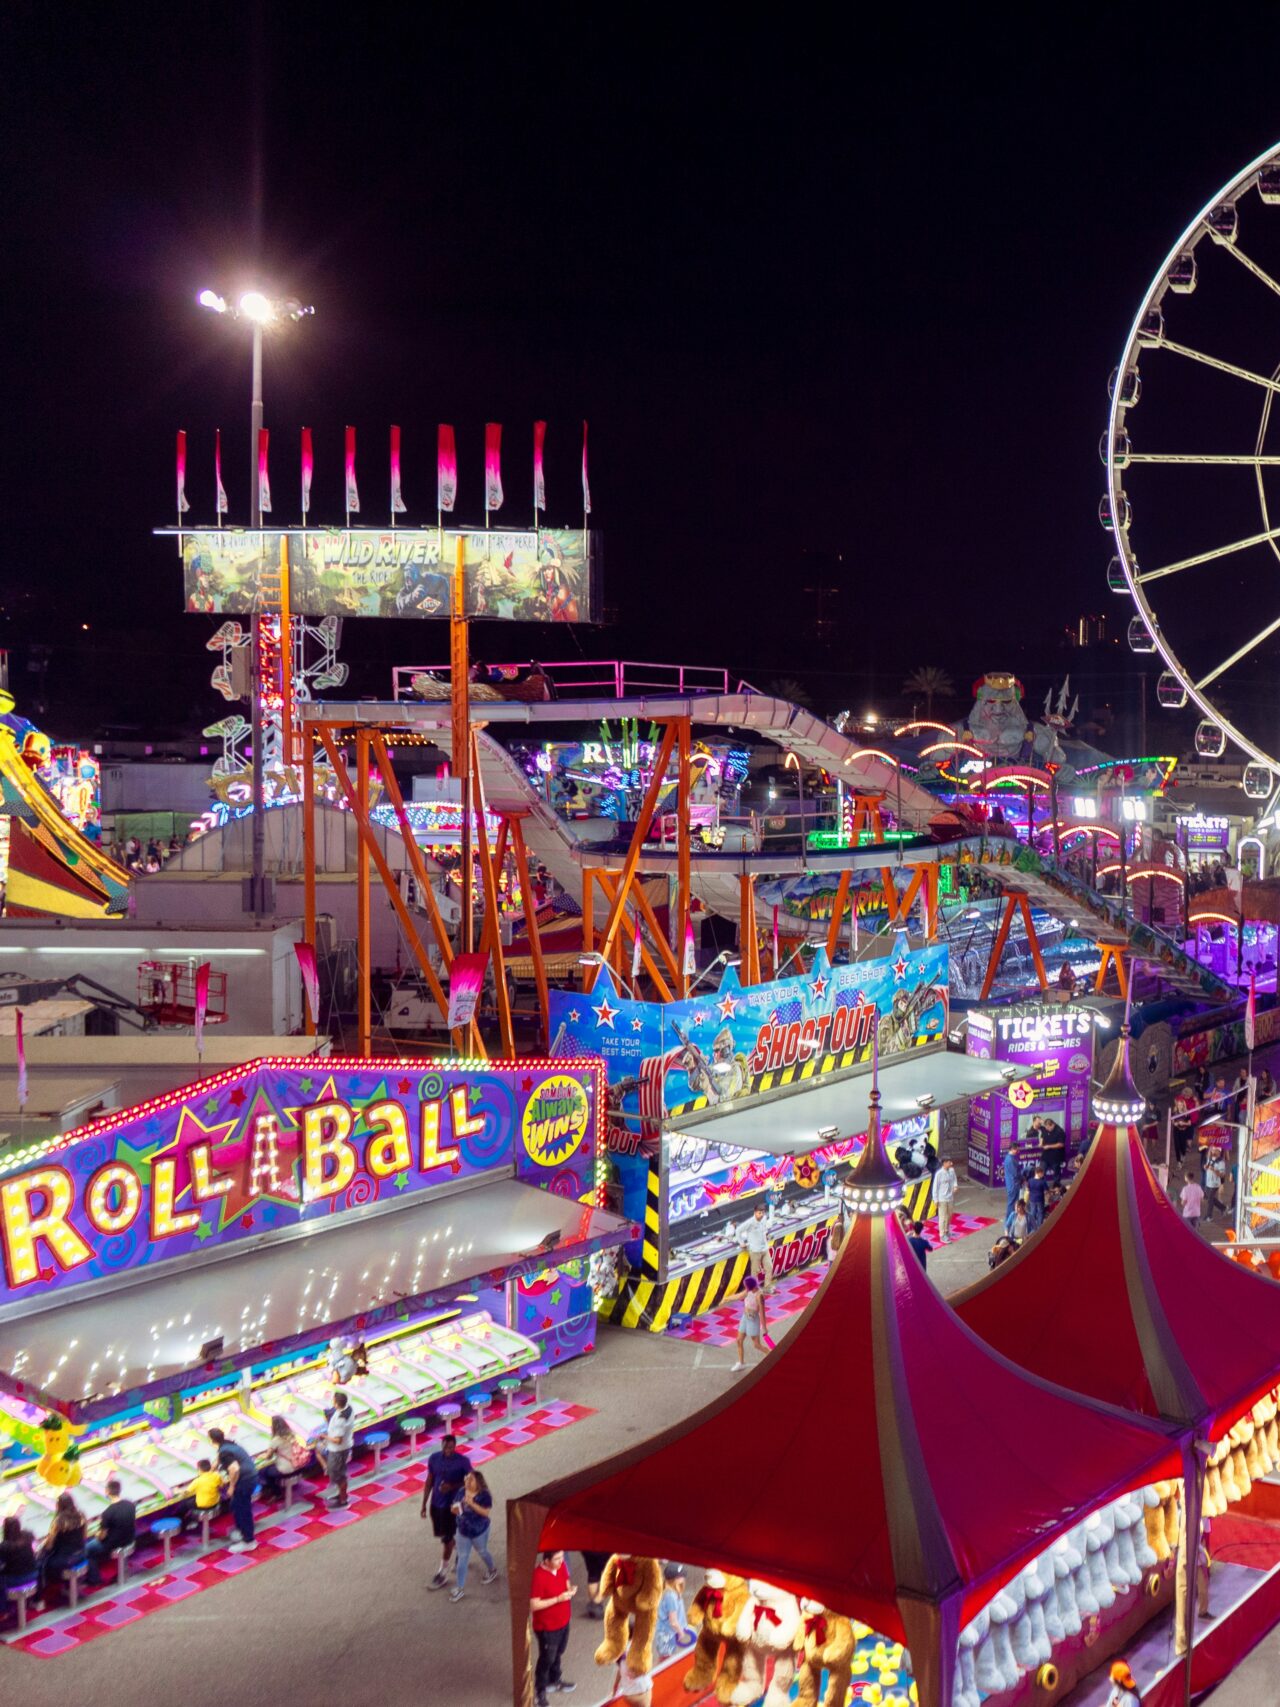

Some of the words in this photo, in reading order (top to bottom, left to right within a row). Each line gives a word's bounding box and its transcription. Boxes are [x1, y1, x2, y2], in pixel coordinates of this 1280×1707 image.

[323, 535, 374, 567] WILD
[376, 534, 440, 567] RIVER
[810, 894, 851, 920] WID
[855, 889, 898, 917] RIVE
[749, 990, 775, 1005] TAKE
[777, 986, 800, 1001] YOUR
[839, 971, 861, 986] BEST
[753, 1013, 831, 1074] SHOOT
[832, 1002, 875, 1054] OUT
[998, 1012, 1091, 1040] TICKETS
[602, 1036, 618, 1047] TAKE
[620, 1037, 640, 1048] YOUR
[602, 1046, 619, 1056] BEST
[621, 1047, 642, 1058] SHOT!
[1008, 1040, 1036, 1053] RIDES
[1047, 1037, 1081, 1051] MES
[531, 1095, 583, 1122] Always
[609, 1127, 641, 1156] OUT
[0, 1142, 235, 1289] ROLL
[249, 1112, 281, 1197] A
